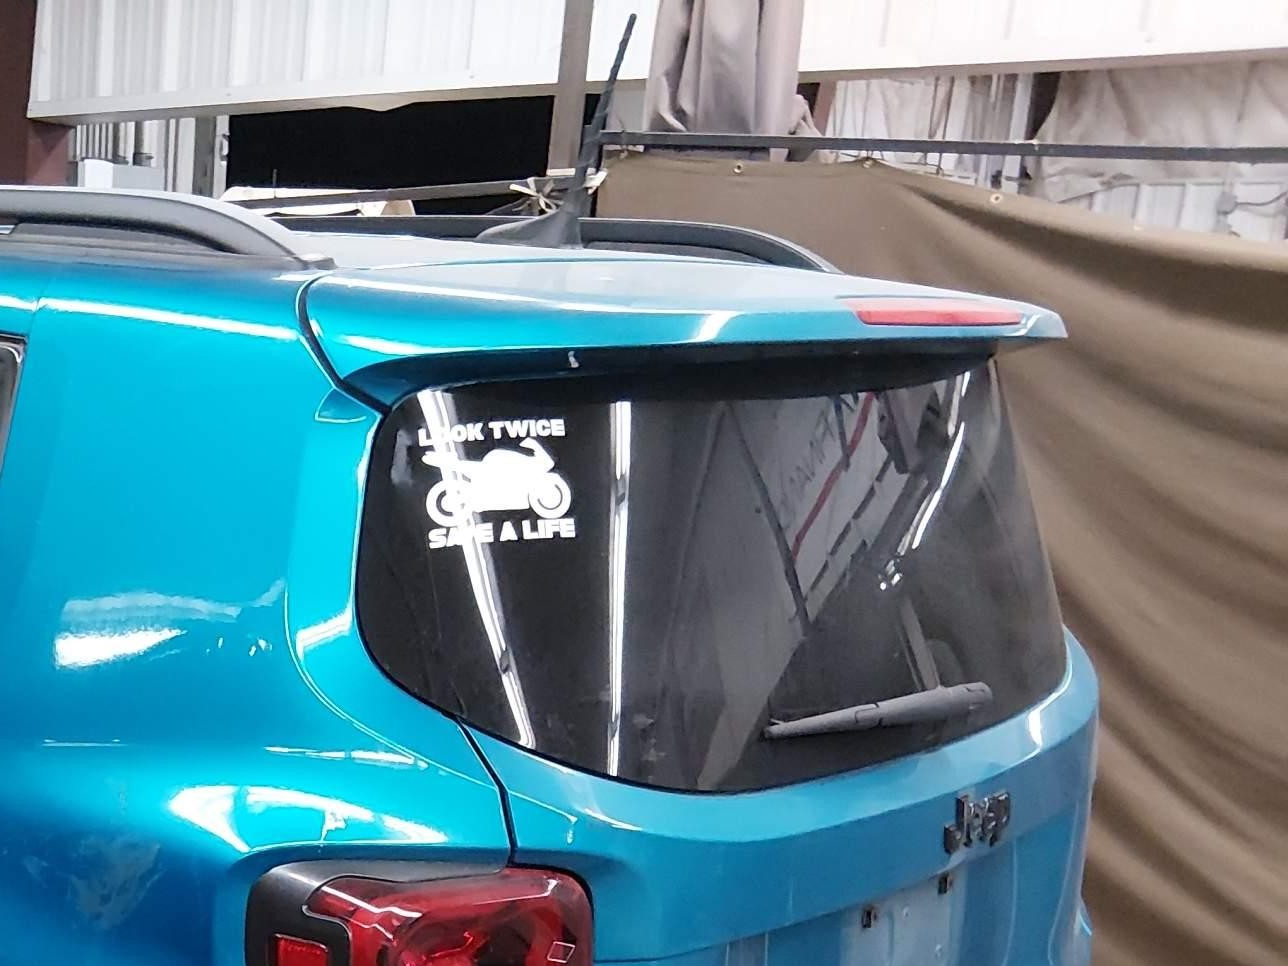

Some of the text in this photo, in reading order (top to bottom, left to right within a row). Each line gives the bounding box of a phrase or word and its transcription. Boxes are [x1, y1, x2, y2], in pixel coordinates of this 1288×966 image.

[417, 418, 566, 447] LOK TWICE
[427, 518, 576, 549] SAE A LIFE
